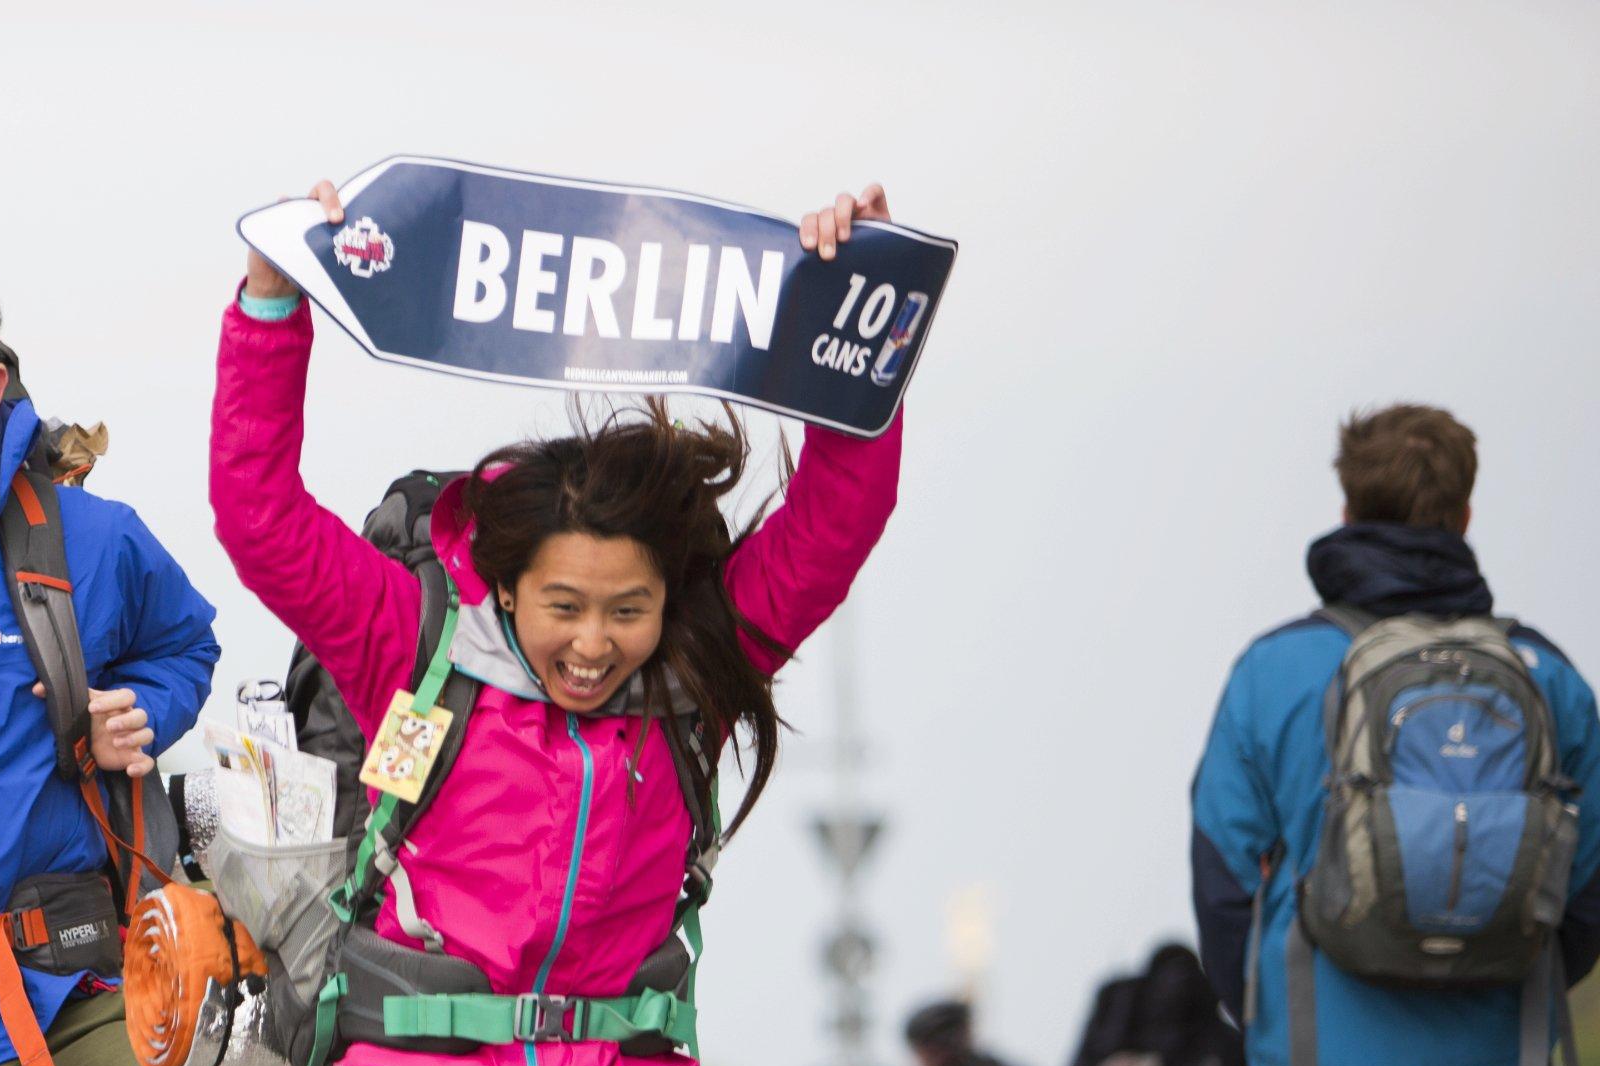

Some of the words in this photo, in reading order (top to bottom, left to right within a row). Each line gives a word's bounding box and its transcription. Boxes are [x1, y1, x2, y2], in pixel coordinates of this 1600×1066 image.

[453, 220, 784, 350] BERLIN
[832, 272, 896, 339] 10
[811, 332, 872, 377] CANS
